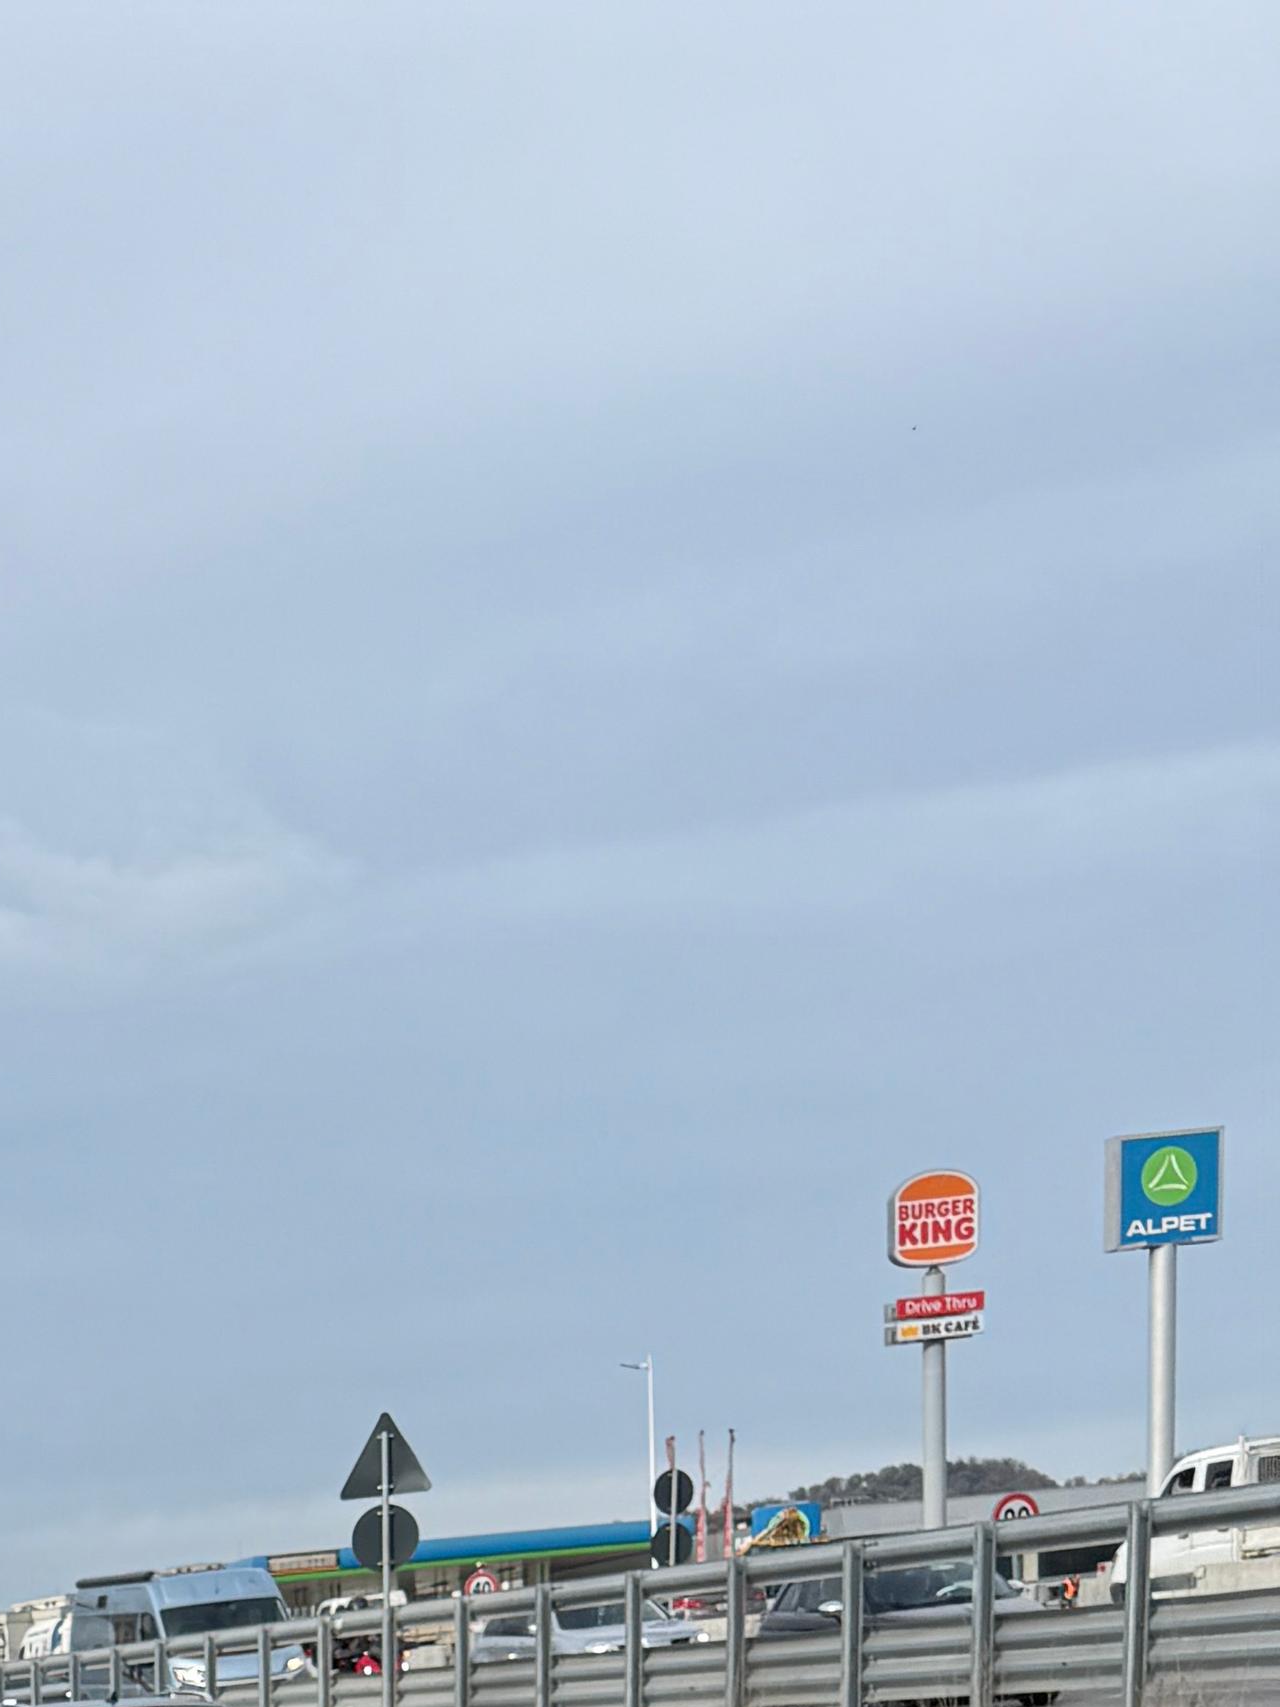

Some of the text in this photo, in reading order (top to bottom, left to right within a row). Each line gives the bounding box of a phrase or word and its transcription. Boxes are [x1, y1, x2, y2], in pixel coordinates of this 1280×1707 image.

[898, 1198, 975, 1222] BURGER
[898, 1217, 975, 1247] KING
[1126, 1212, 1213, 1237] ALPET
[905, 1296, 977, 1315] Drive Thru
[944, 1316, 980, 1334] CAFÉ
